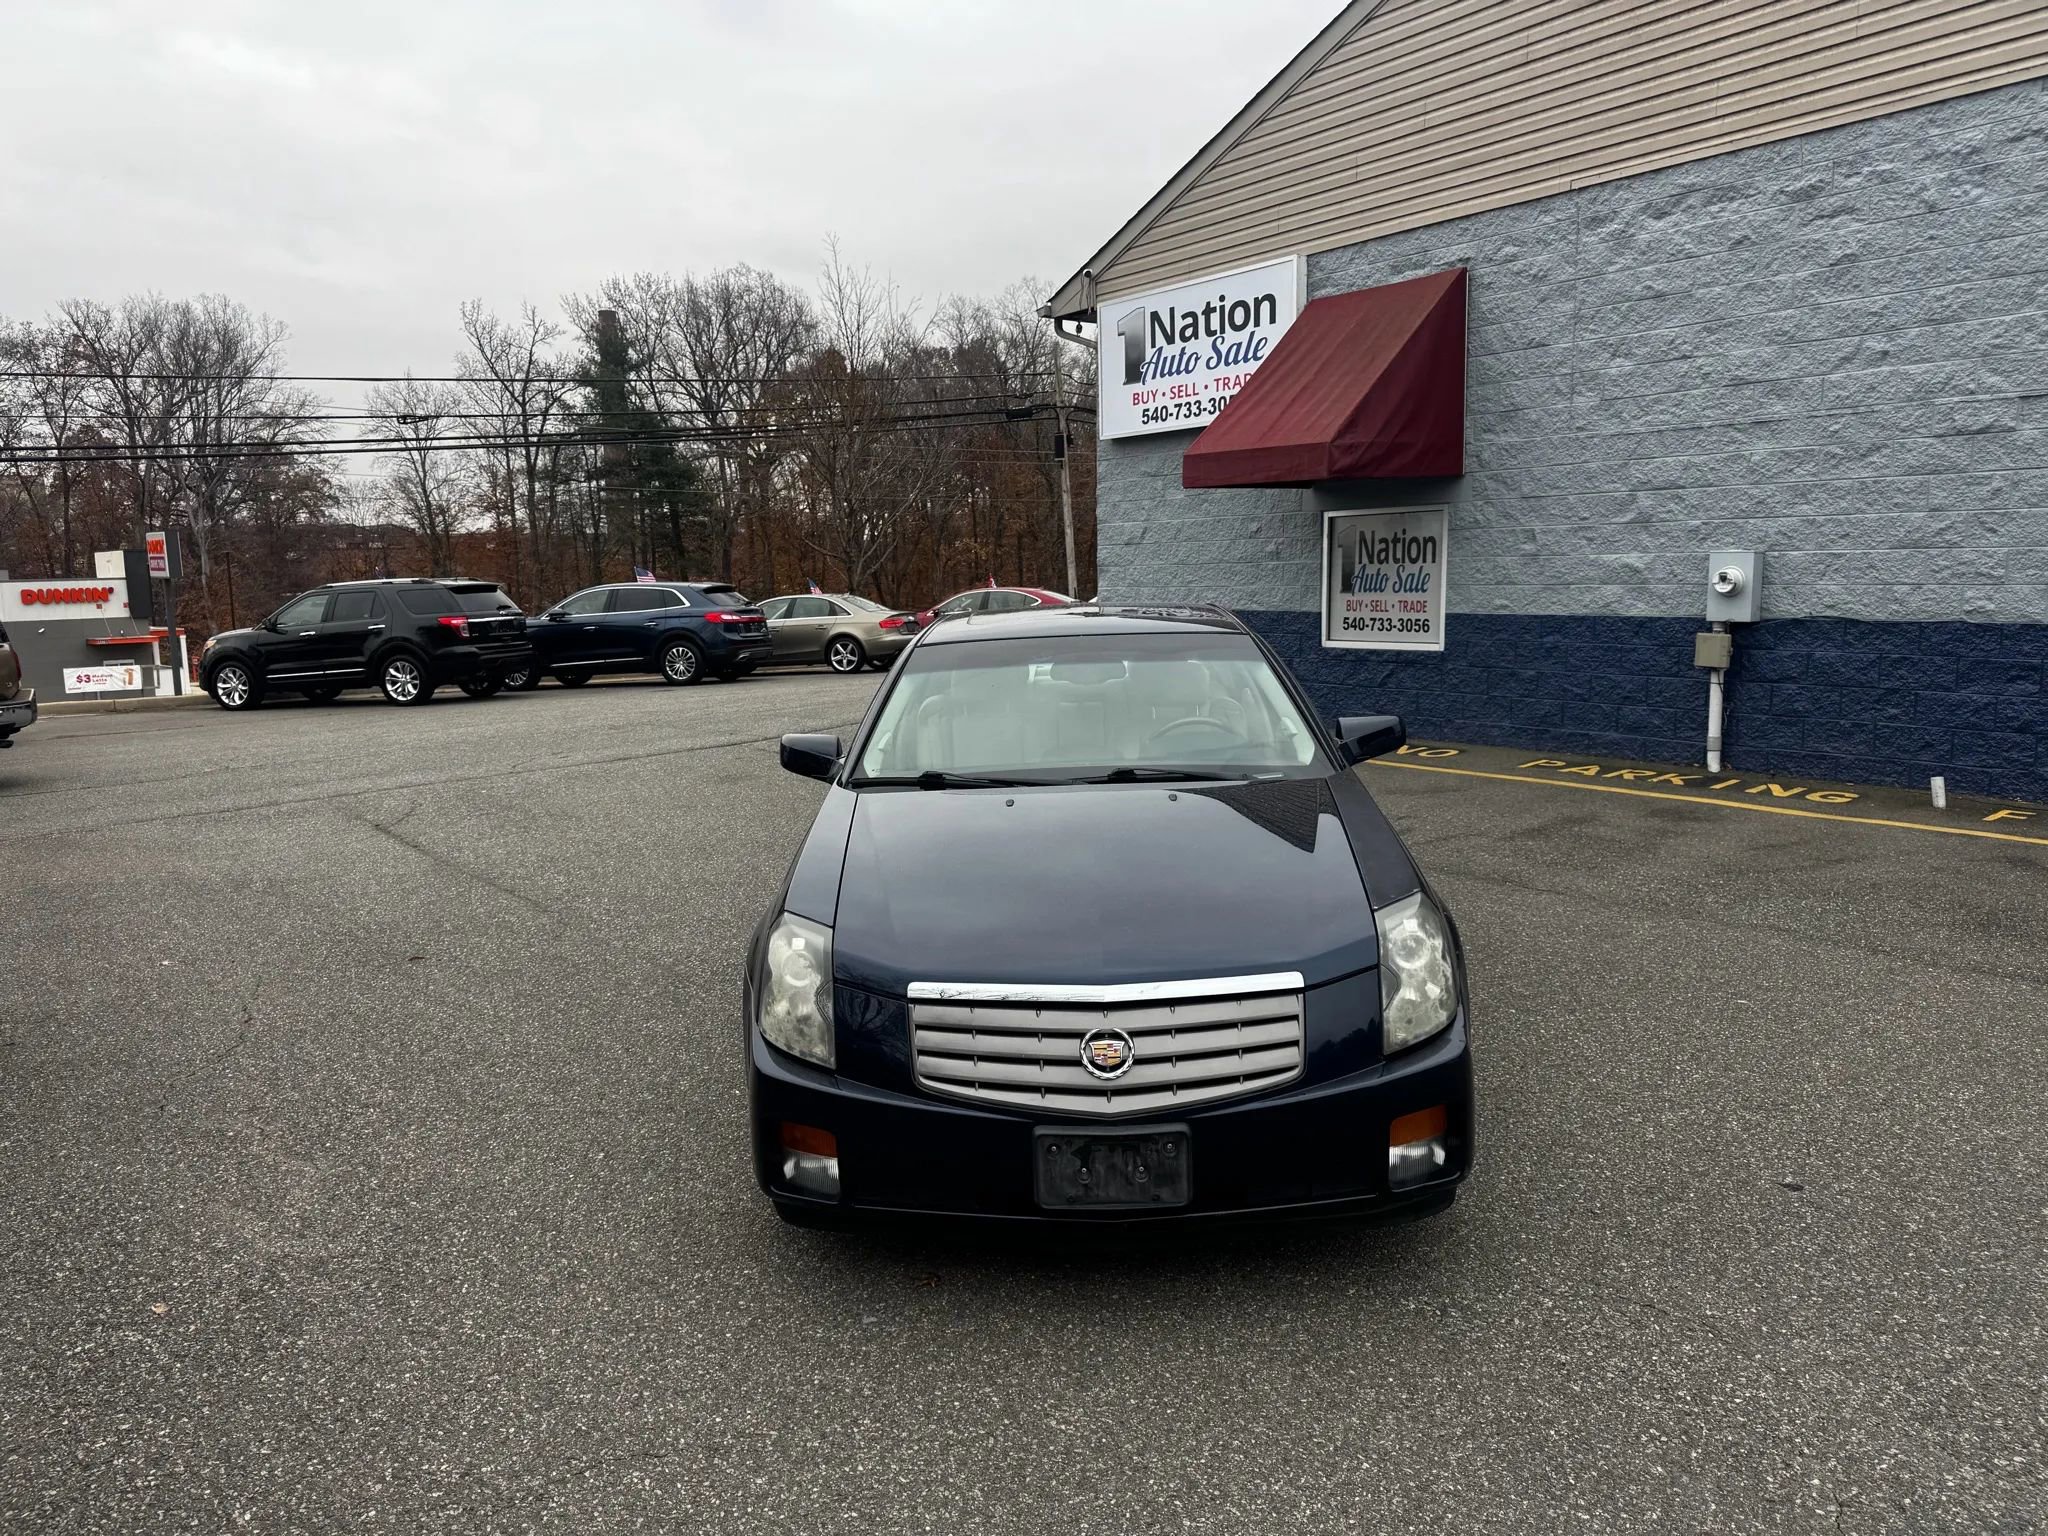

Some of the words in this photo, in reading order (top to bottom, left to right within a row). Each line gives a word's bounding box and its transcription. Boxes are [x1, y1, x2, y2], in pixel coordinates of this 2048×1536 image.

[1117, 306, 1146, 386] 1
[1149, 292, 1277, 349] Nation
[1140, 345, 1202, 385] Auto
[1205, 330, 1268, 371] Sale
[1132, 388, 1159, 406] BUY
[1169, 382, 1200, 400] SELL
[1213, 372, 1254, 393] TRAD
[1141, 396, 1234, 425] 540-733-30
[1337, 524, 1357, 594] 1
[1358, 528, 1437, 565] Nation
[21, 586, 114, 605] DUNKIN'
[1351, 563, 1390, 596] Auto
[1392, 564, 1431, 594] Sale
[1345, 599, 1364, 612] BUY
[1369, 600, 1390, 613] SELL
[1397, 600, 1428, 613] TRADE
[1342, 616, 1431, 633] 540-733-3056
[76, 674, 92, 684] $3
[1396, 744, 1460, 758] NO
[1517, 758, 1860, 803] PARKING
